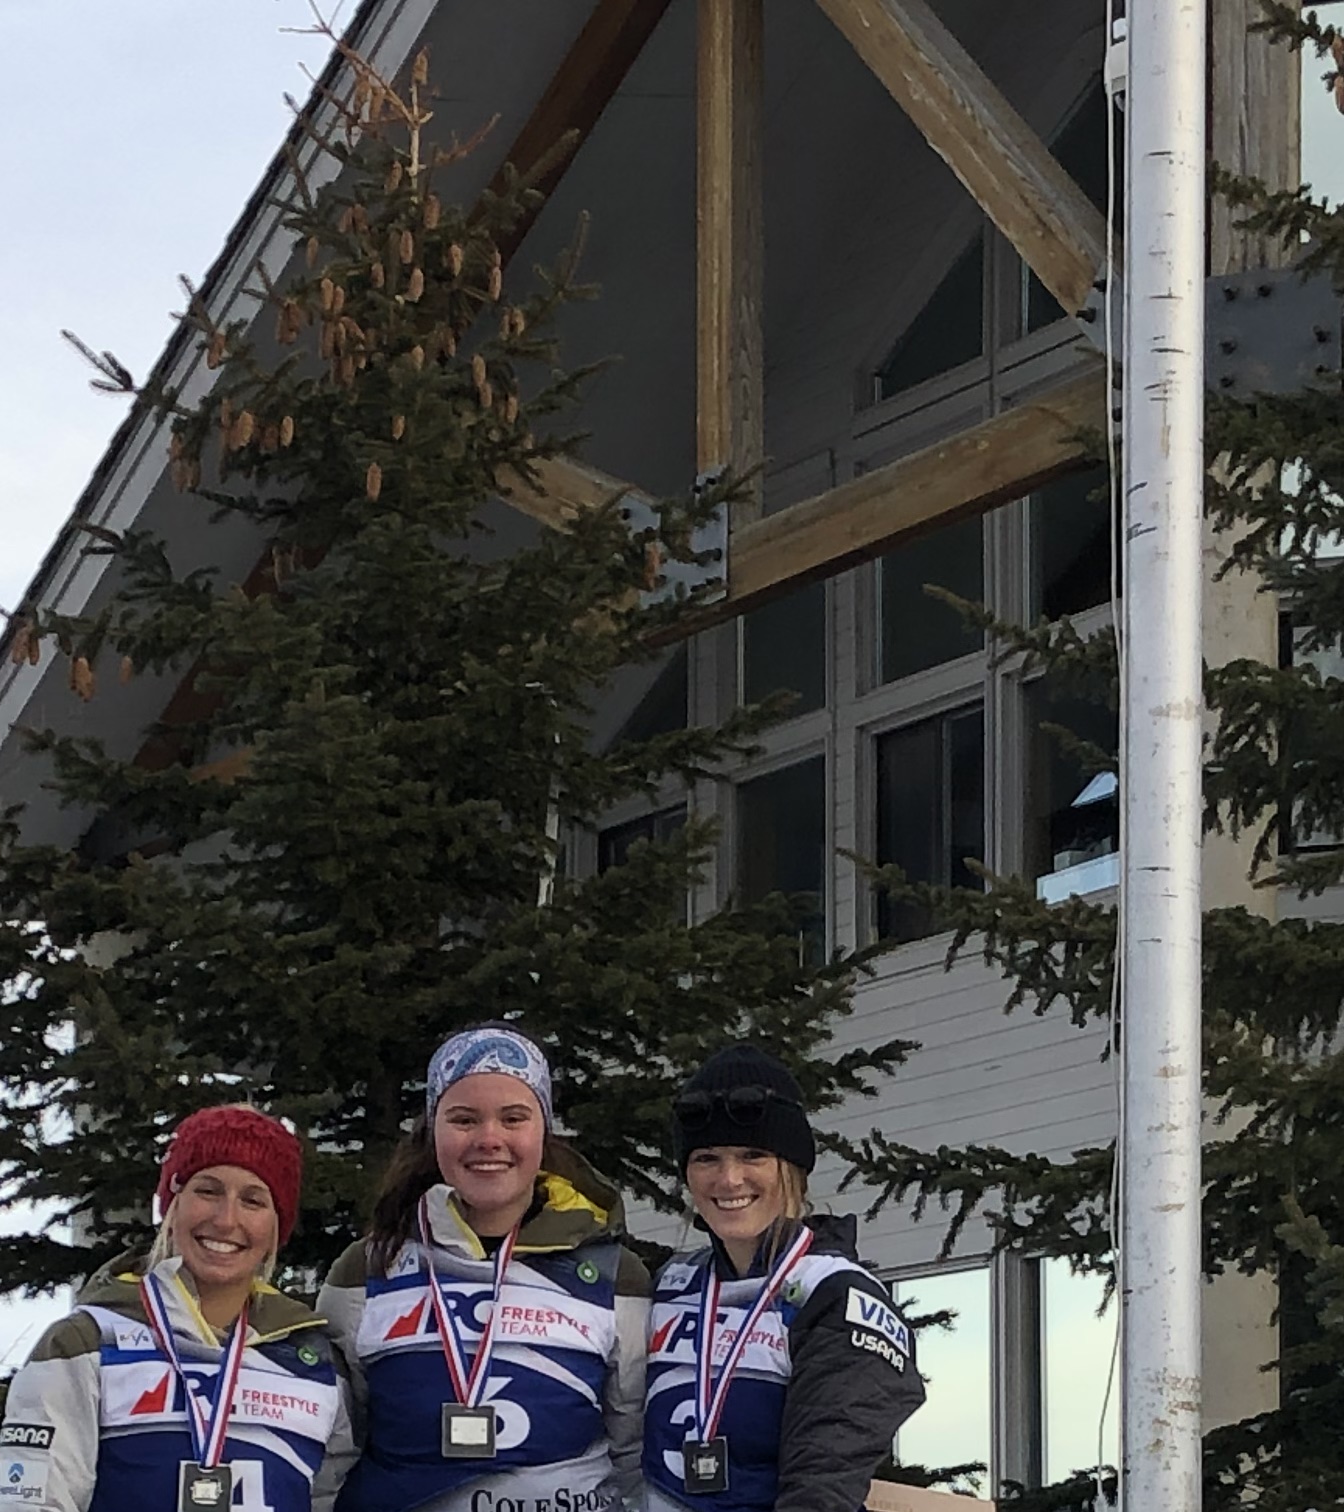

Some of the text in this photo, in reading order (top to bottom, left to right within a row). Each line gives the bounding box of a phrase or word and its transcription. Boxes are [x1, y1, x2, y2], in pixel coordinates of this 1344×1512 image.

[500, 1322, 548, 1337] TEAM
[501, 1306, 590, 1336] FREESTYLE
[853, 1293, 907, 1350] VISA
[851, 1330, 905, 1373] USANA
[242, 1389, 320, 1417] FREESTYLE
[242, 1405, 284, 1421] TEAM
[478, 1376, 531, 1450] 6
